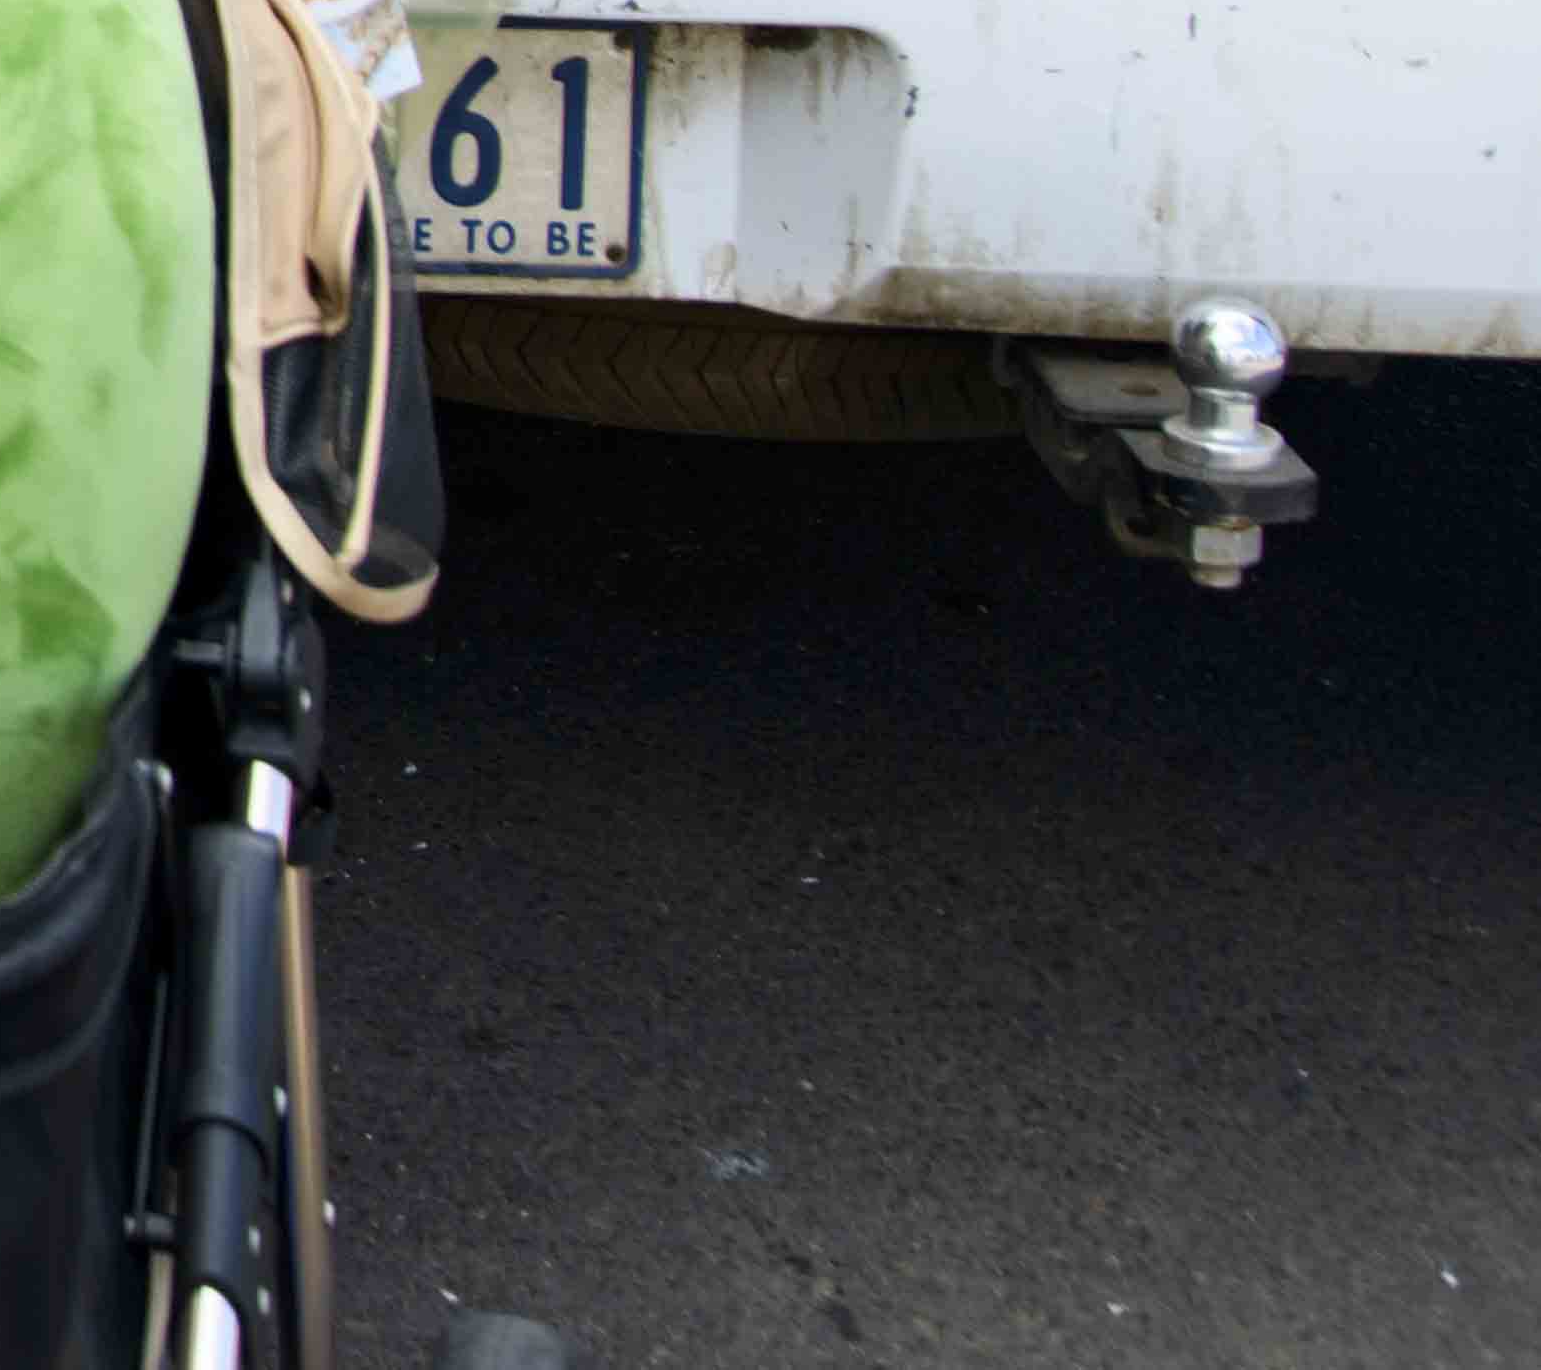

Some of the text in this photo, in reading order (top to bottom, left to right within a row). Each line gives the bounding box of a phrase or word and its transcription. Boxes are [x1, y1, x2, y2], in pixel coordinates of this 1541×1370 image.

[429, 54, 590, 212] 61
[460, 218, 516, 255] TO
[545, 220, 597, 257] BE
